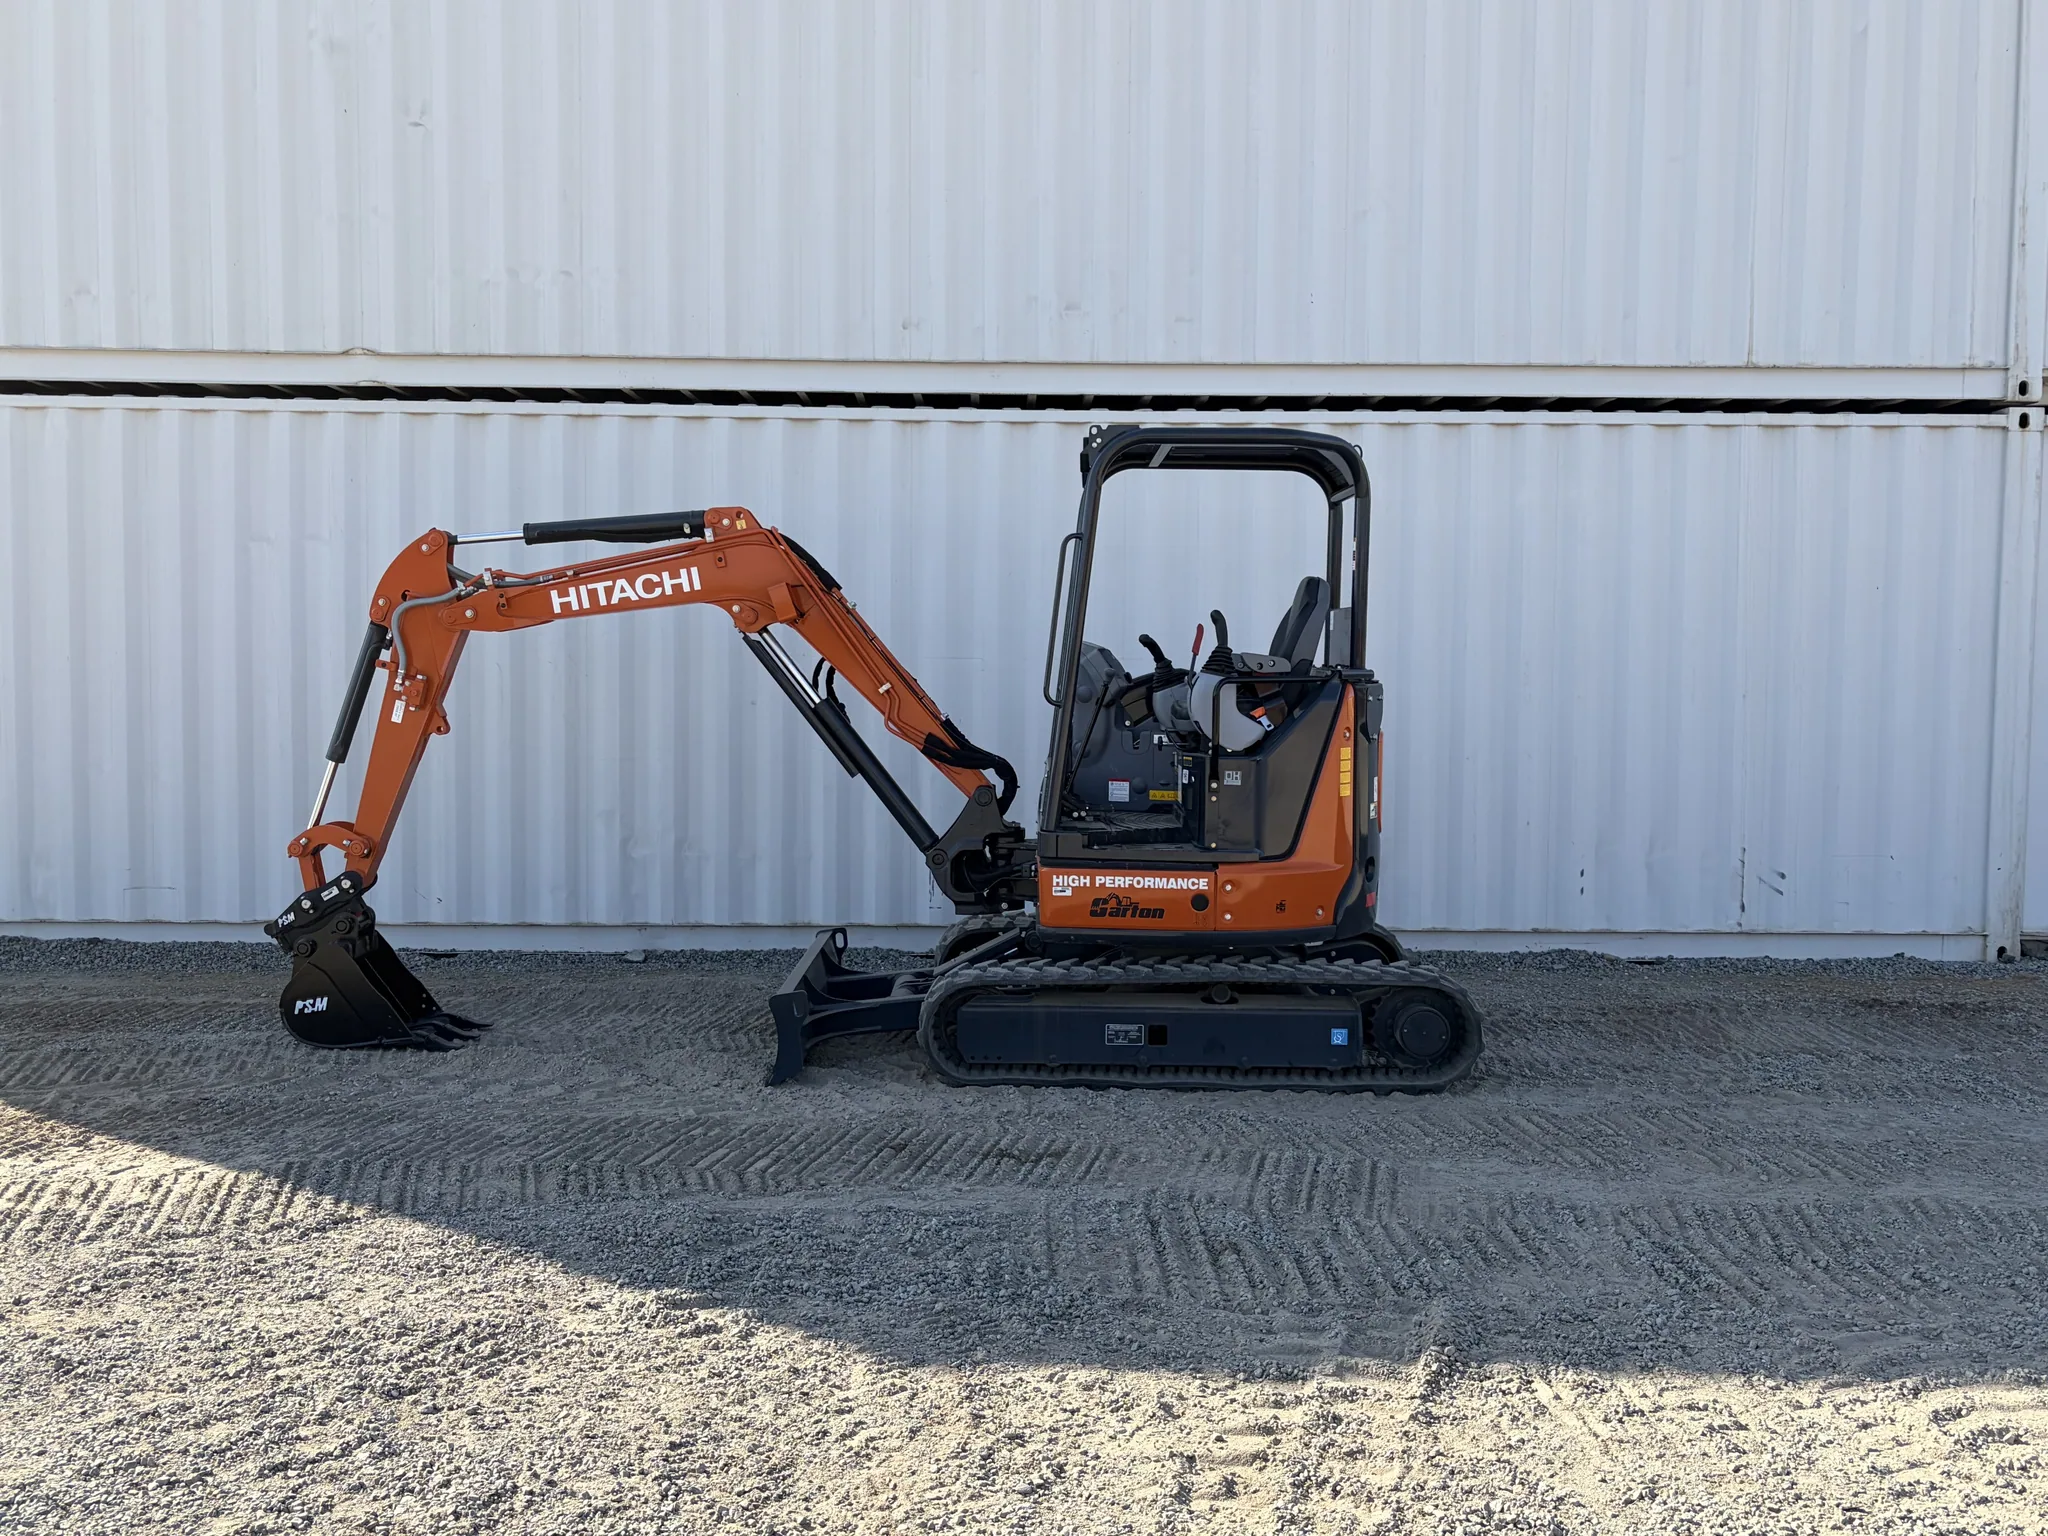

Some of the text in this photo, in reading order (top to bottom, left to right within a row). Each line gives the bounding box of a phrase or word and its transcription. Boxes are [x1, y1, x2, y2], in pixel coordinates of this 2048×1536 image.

[550, 566, 702, 614] HITACHI
[1052, 875, 1209, 890] HIGH PERFORMANCE
[277, 911, 296, 928] PSM
[294, 996, 329, 1015] PSM
